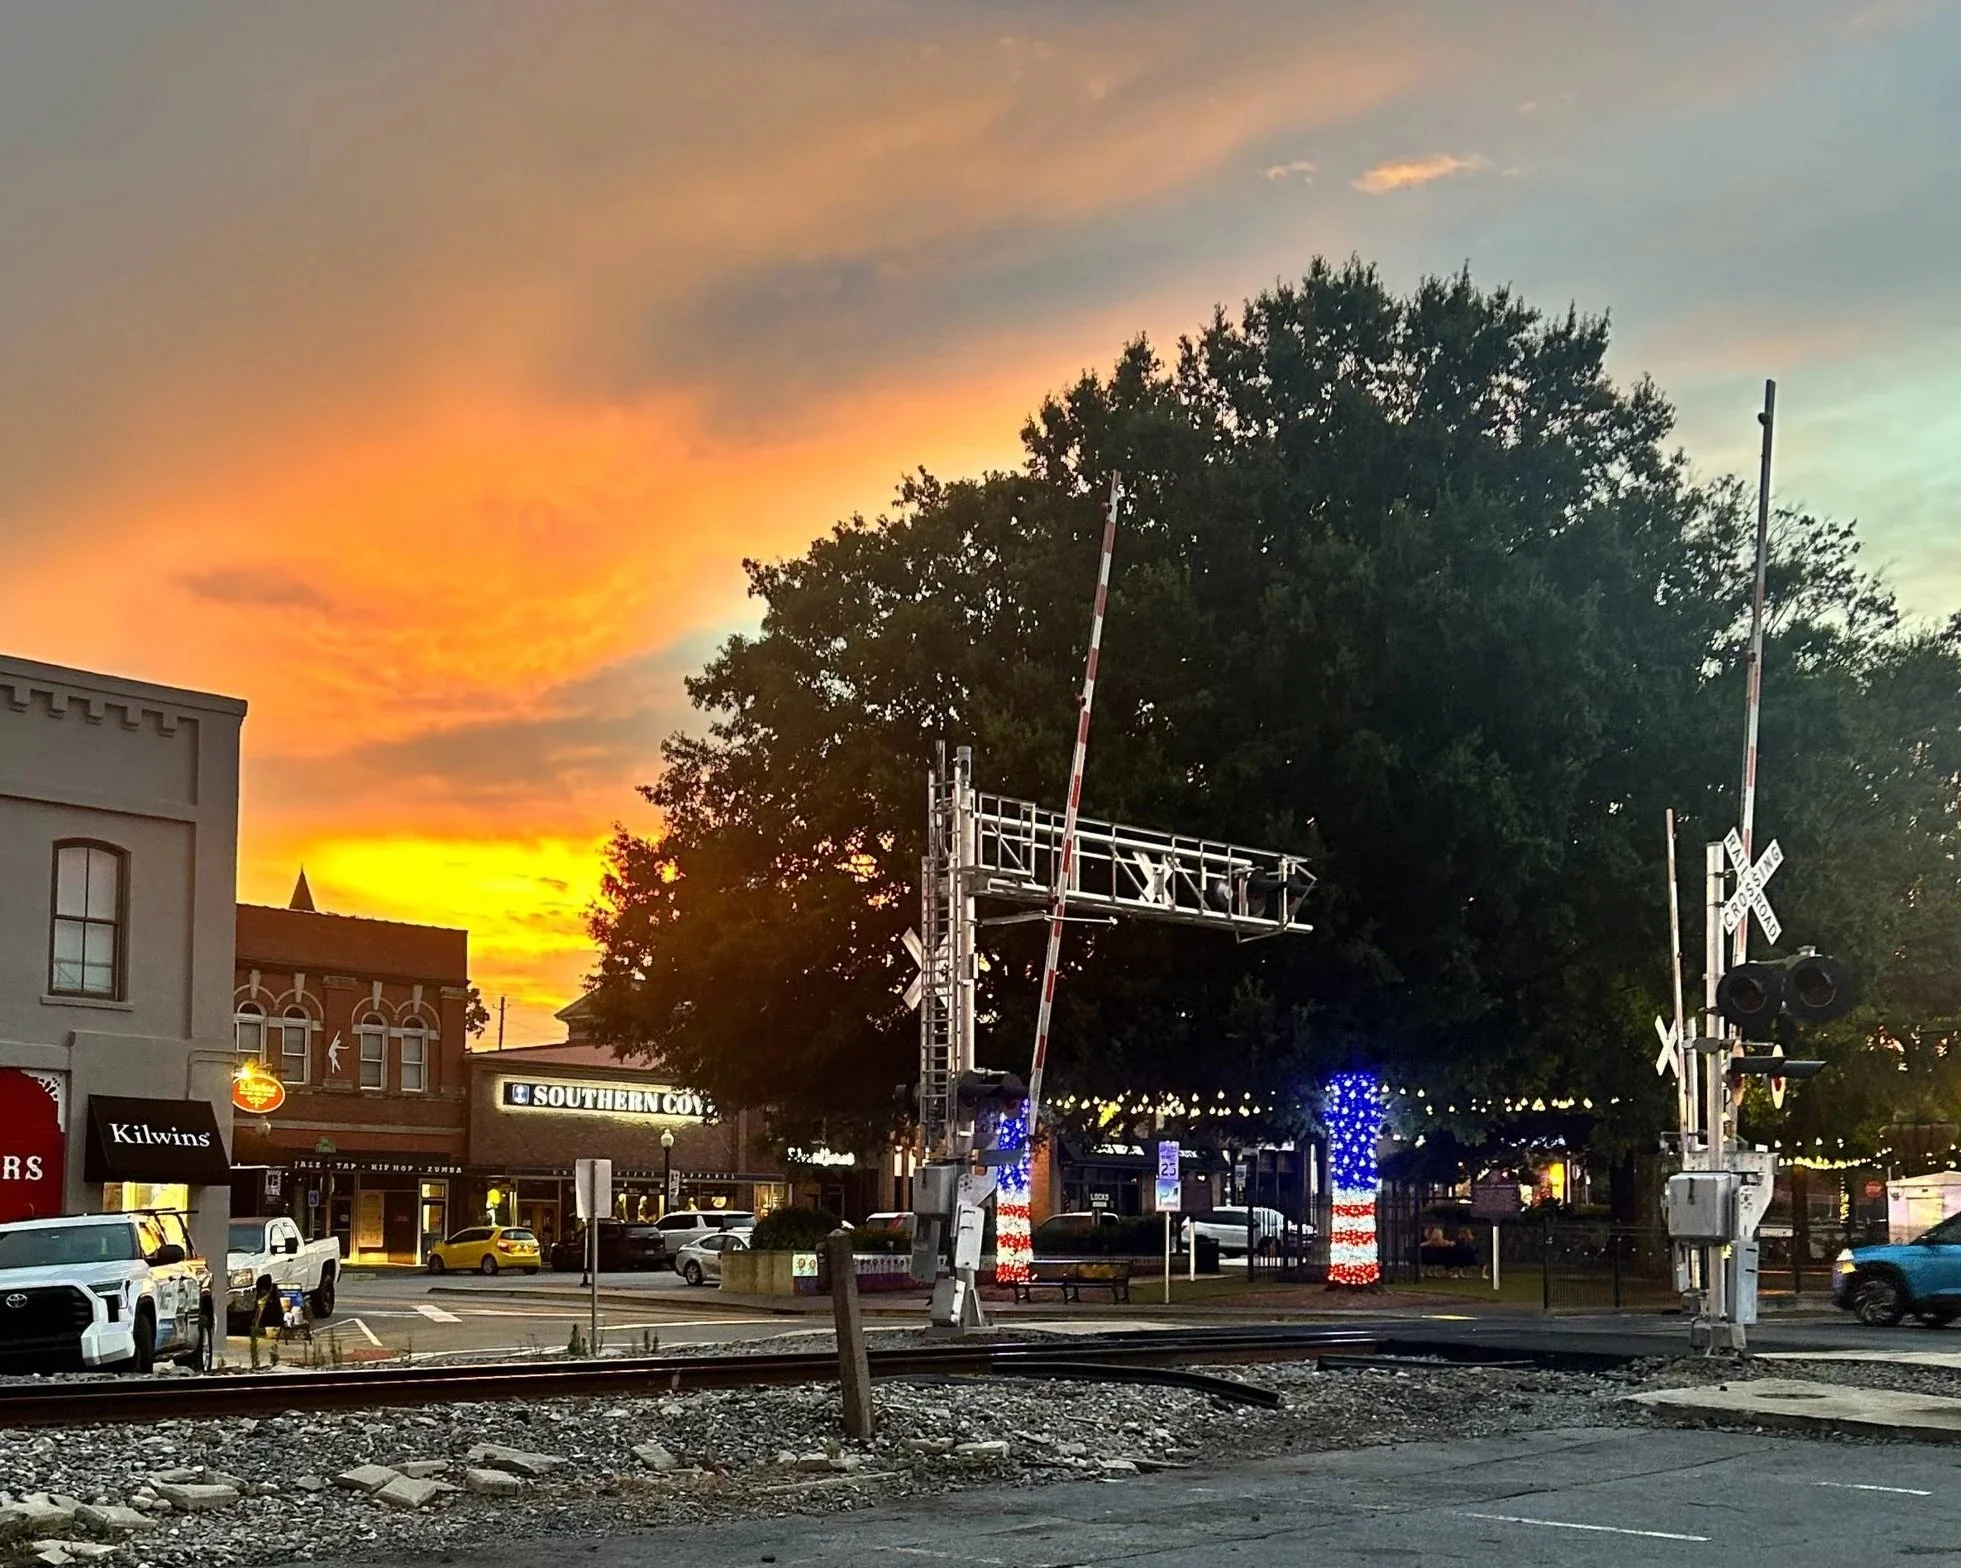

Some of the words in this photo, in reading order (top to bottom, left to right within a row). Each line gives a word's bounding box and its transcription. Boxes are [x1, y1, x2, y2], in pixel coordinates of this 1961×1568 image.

[1723, 846, 1780, 927] CROSSING
[533, 1085, 660, 1113] SOUTHERN
[662, 1092, 720, 1117] COV
[109, 1123, 209, 1147] Kilwins
[294, 1160, 321, 1169] JAZZ
[336, 1161, 357, 1170] TAP
[371, 1163, 389, 1172] HIP
[393, 1164, 414, 1172] HOP
[427, 1165, 462, 1174] ZUMBA
